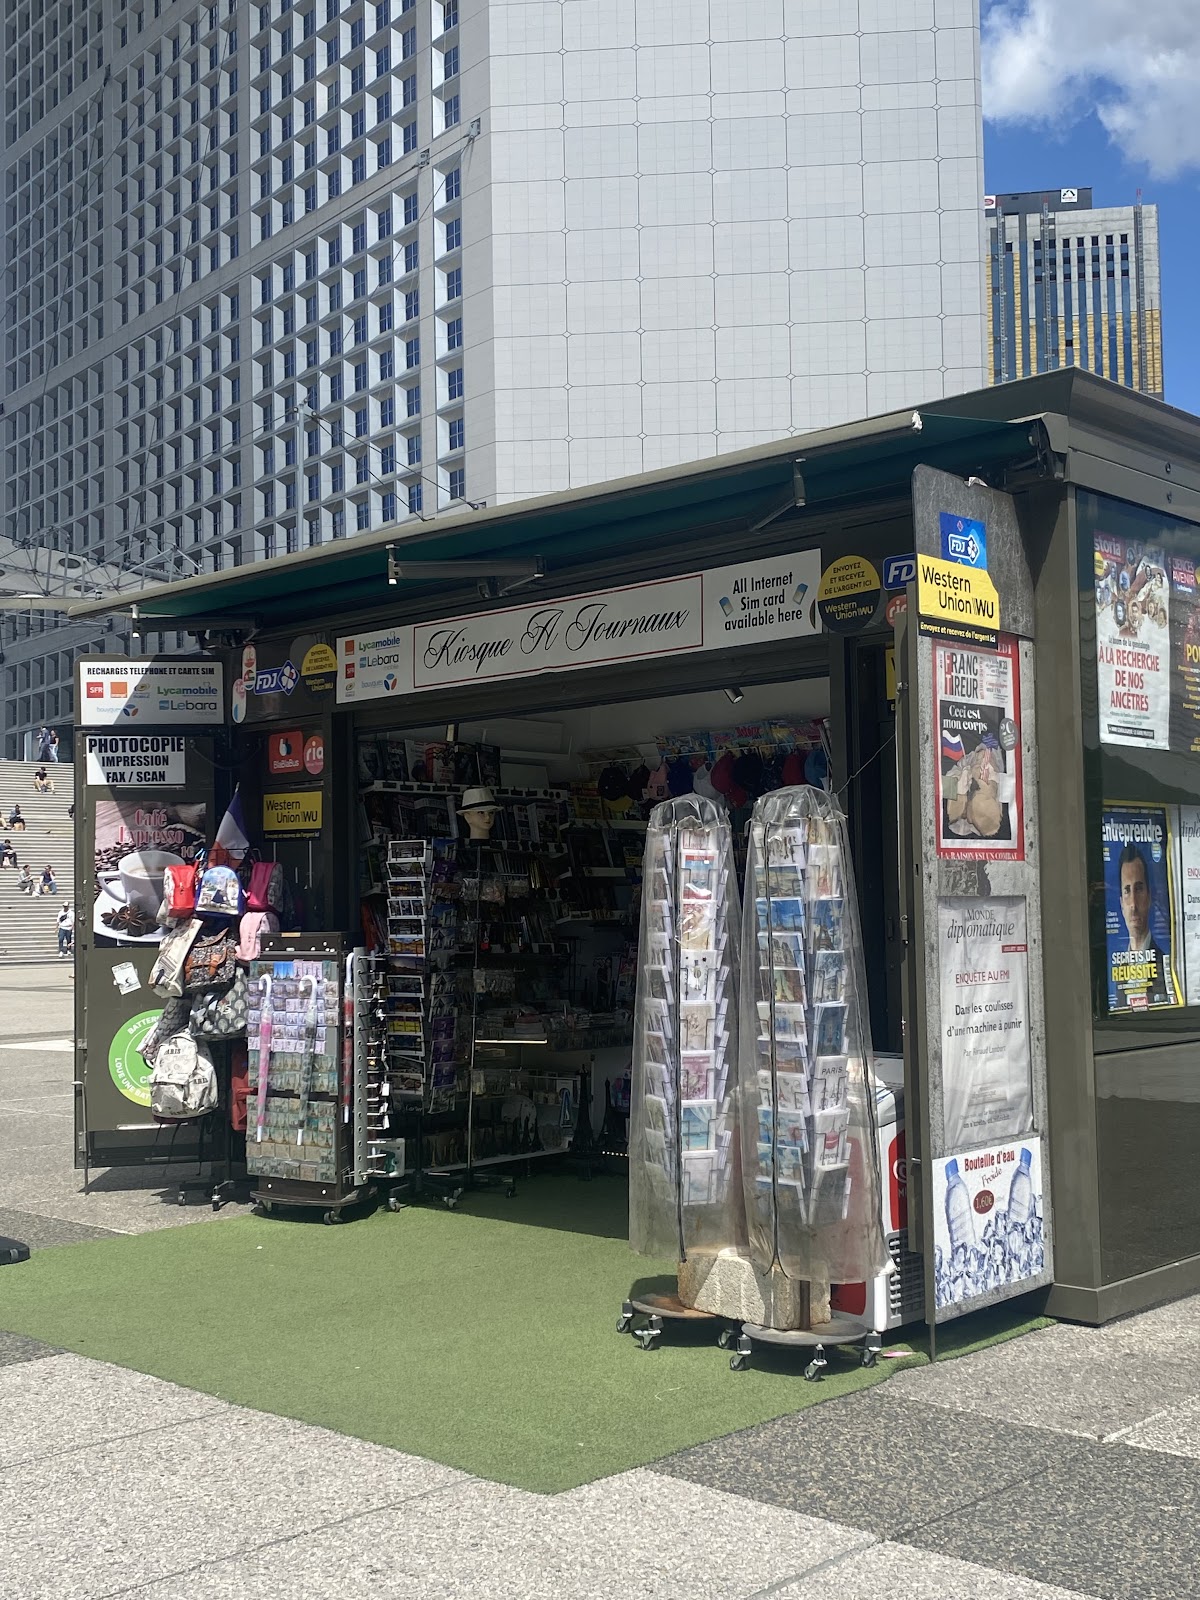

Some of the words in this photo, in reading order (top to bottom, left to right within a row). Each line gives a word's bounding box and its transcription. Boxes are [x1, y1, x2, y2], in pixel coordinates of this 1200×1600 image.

[951, 541, 965, 553] FDJ
[1094, 536, 1121, 556] storia
[833, 562, 861, 574] ENVOYEZ
[888, 560, 916, 583] FD
[733, 579, 747, 594] All
[750, 572, 793, 592] Internet
[838, 571, 865, 582] RECEVEZ
[922, 565, 971, 593] Western
[1173, 570, 1195, 586] AVENIR
[834, 582, 862, 593] L'ARGENT
[740, 596, 758, 611] Sim
[760, 589, 785, 608] card
[825, 602, 857, 613] Western
[938, 590, 972, 614] Union
[976, 598, 995, 618] WU
[725, 612, 775, 631] available
[778, 608, 803, 624] here
[836, 610, 857, 620] Union
[859, 605, 873, 615] WU
[423, 627, 514, 674] Kiosque
[520, 608, 564, 654] A
[565, 603, 689, 651] Journaux
[920, 622, 940, 633] Envoyez
[947, 628, 965, 637] recevez
[965, 630, 971, 639] de
[972, 632, 990, 642] l'argent
[359, 636, 400, 652] Lycamobile
[997, 643, 1012, 654] EDI
[367, 654, 399, 667] Lebara
[945, 651, 978, 676] FRANC
[1099, 641, 1105, 662] À
[1106, 648, 1114, 665] LA
[1116, 649, 1160, 672] RECHERCHE
[87, 667, 128, 675] RECHARGES
[130, 667, 167, 675] TELEPHONE
[169, 667, 176, 675] ET
[178, 667, 200, 675] CARTE
[201, 667, 214, 675] SIM
[256, 673, 277, 690] FDJ
[945, 674, 979, 699] TIREUR
[1115, 670, 1126, 687] DE
[1128, 672, 1144, 689] NOS
[157, 686, 218, 696] Lycamobile
[171, 700, 217, 711] Lebara
[1111, 689, 1149, 711] ANCÊTRES
[949, 705, 966, 718] Ceci
[967, 709, 981, 719] est
[943, 718, 962, 730] mon
[962, 721, 988, 734] corps
[88, 737, 184, 753] PHOTOCOPIE
[102, 755, 169, 767] IMPRESSION
[273, 759, 300, 769] BlaBlaBus
[106, 772, 126, 783] FAX
[136, 771, 166, 783] SCAN
[266, 800, 300, 811] Western
[135, 808, 167, 827] Café
[277, 812, 300, 823] Union
[303, 811, 318, 822] WU
[119, 826, 184, 847] Expresso
[940, 852, 950, 860] LA
[950, 852, 974, 860] RAISON
[995, 852, 1017, 860] COMBAT
[967, 909, 995, 920] MONDE
[947, 919, 1015, 943] diplomatique
[1112, 951, 1143, 964] SECRETS
[1145, 949, 1156, 961] DE
[955, 970, 986, 984] ENQUÊTE
[988, 971, 999, 981] AU
[1000, 970, 1010, 980] FMI
[955, 1004, 970, 1015] Dans
[971, 1003, 982, 1013] les
[984, 1000, 1013, 1012] coulisses
[127, 1015, 160, 1035] BATTER
[947, 1026, 965, 1037] d'une
[966, 1022, 997, 1035] machine
[999, 1020, 1003, 1030] à
[1003, 1018, 1022, 1032] punir
[822, 1066, 843, 1075] PARIS
[115, 1058, 125, 1079] LOUE
[122, 1077, 136, 1093] UNE
[135, 1089, 150, 1101] BAT
[964, 1153, 995, 1172] Bouteille
[997, 1150, 1015, 1164] d'eau
[982, 1167, 1003, 1187] Froide
